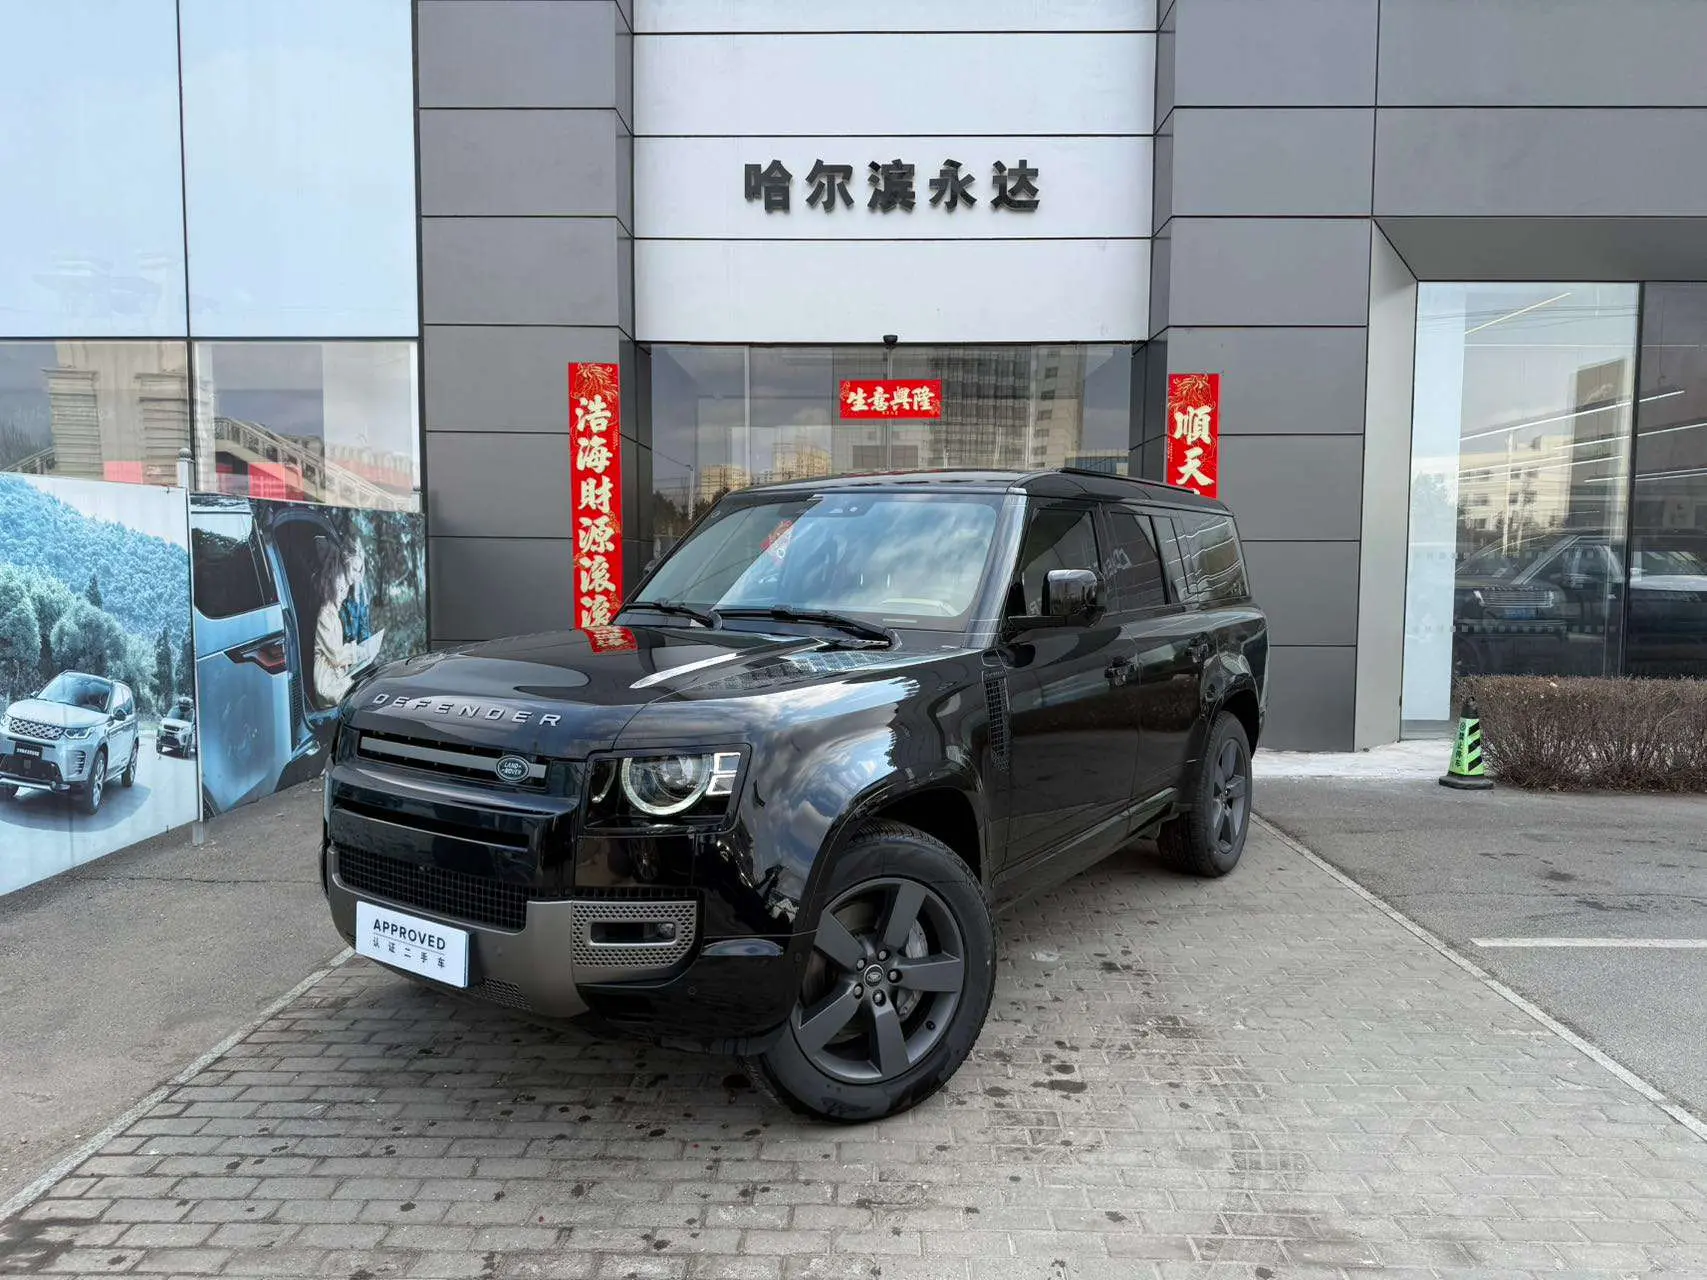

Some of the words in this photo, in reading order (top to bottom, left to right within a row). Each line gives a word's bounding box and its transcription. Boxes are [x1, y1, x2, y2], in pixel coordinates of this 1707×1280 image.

[744, 158, 1041, 214] 哈尔滨永达
[1174, 405, 1215, 494] 順天
[372, 693, 562, 727] DEFENDER
[373, 919, 446, 950] APPROVED
